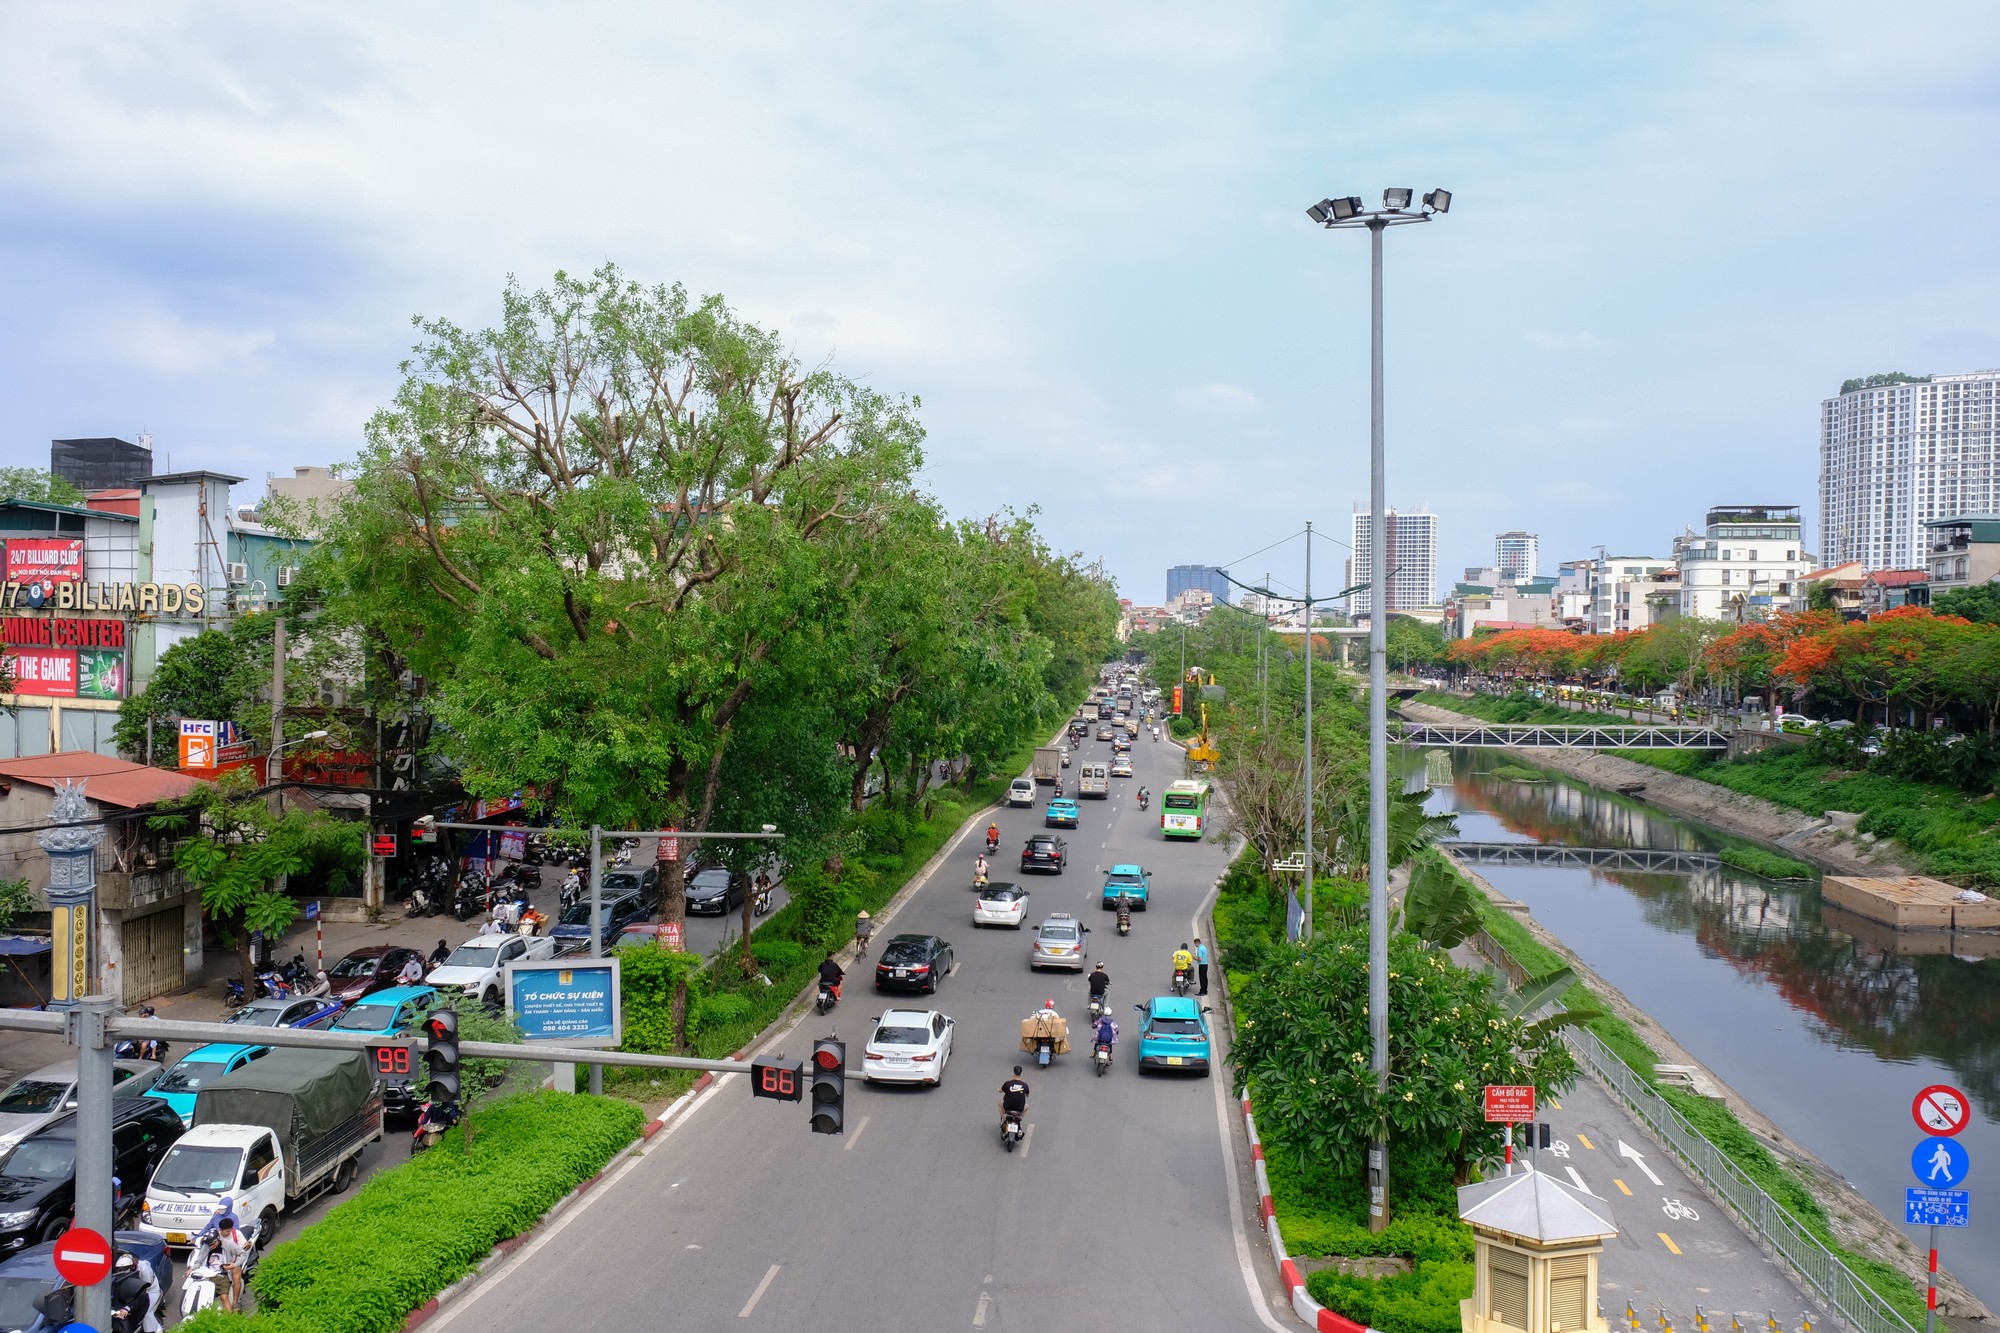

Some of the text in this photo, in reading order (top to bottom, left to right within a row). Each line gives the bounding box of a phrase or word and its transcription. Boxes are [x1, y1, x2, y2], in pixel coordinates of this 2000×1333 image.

[11, 550, 78, 565] 24/7 BILLIARD CLUB
[59, 582, 205, 613] BILLIARDS
[54, 618, 124, 646] CENTER
[20, 656, 38, 680] THE
[41, 656, 70, 681] GAME
[184, 724, 211, 733] HFC
[540, 992, 565, 1000] CHỨC
[567, 991, 581, 1000] SỰ
[582, 990, 604, 1000] KIỆN
[377, 1047, 409, 1073] 99
[763, 1066, 794, 1094] 66
[1492, 1087, 1504, 1096] CẤM
[1516, 1087, 1528, 1096] RÁC
